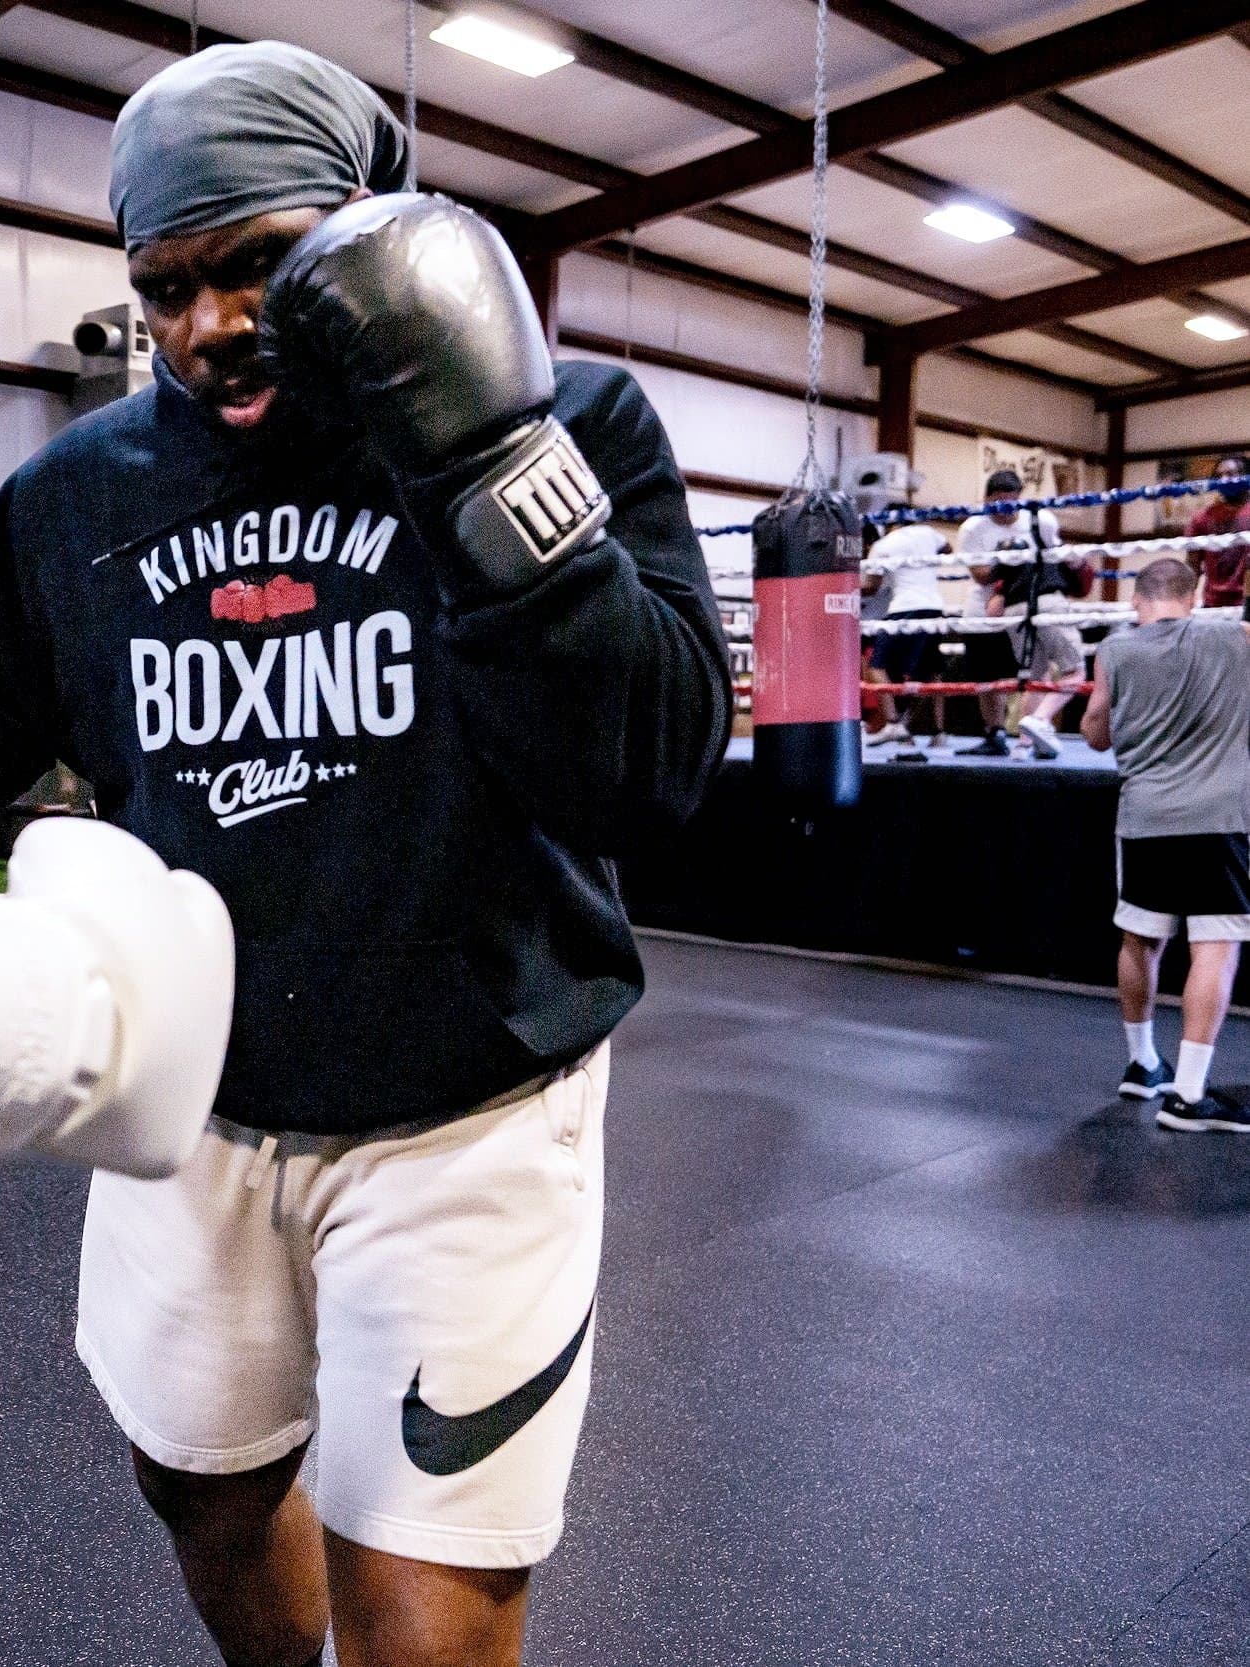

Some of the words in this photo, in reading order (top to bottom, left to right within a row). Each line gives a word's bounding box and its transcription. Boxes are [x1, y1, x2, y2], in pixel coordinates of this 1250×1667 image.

[139, 504, 399, 605] KINGDOM
[130, 610, 415, 752] BOXING
[208, 749, 311, 815] Club
